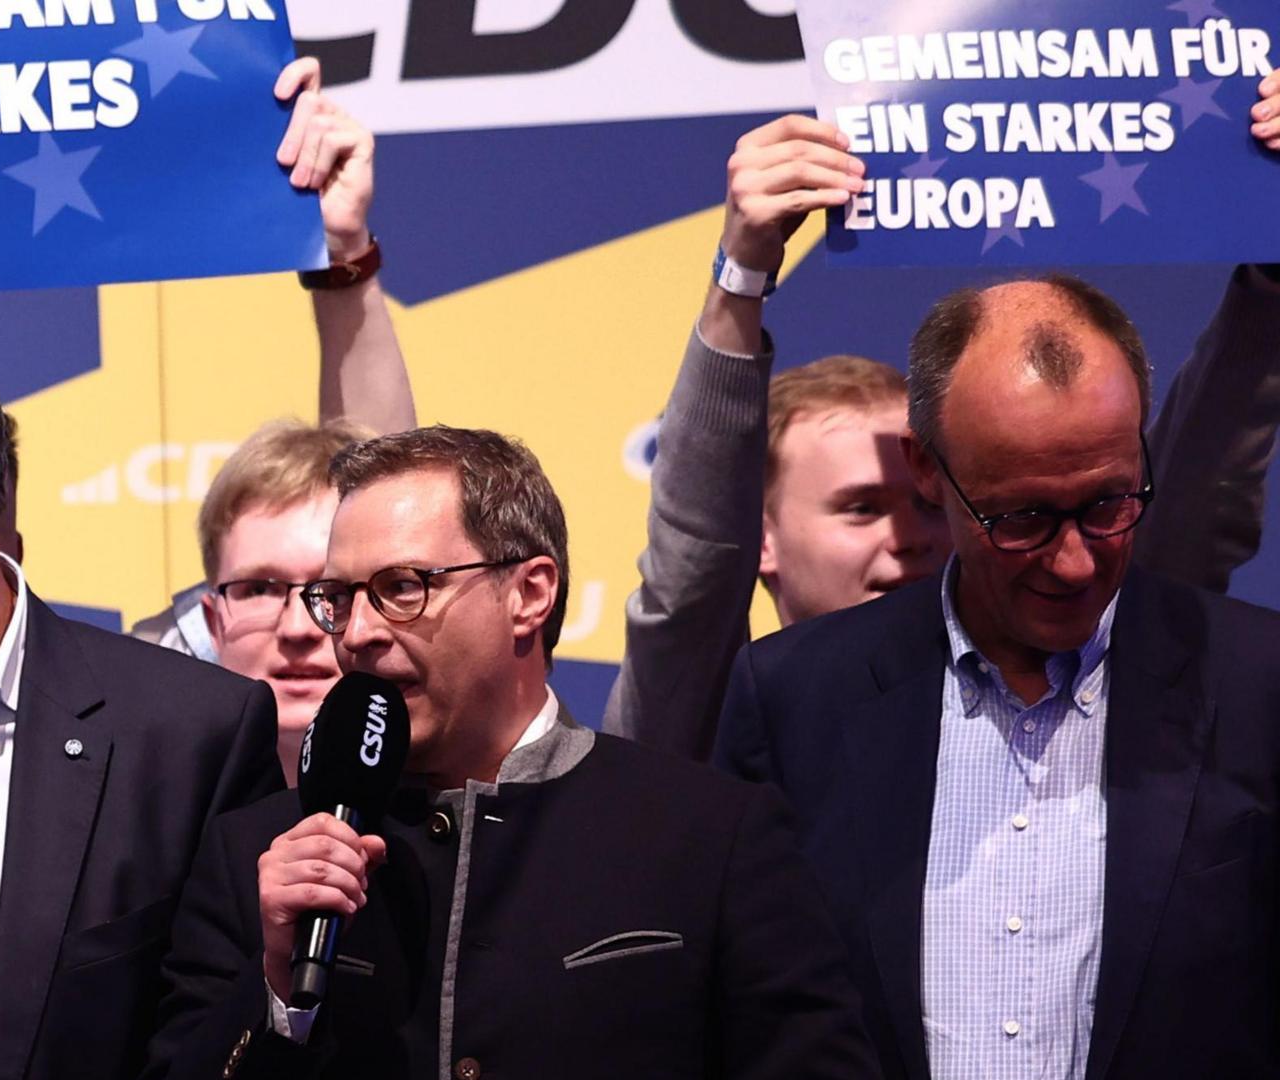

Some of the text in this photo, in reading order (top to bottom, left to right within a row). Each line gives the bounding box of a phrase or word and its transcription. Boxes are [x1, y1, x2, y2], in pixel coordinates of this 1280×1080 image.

[824, 28, 1159, 84] GEMEINSAM
[1170, 18, 1274, 78] FÜR
[835, 101, 1175, 153] EIN STARKES
[844, 177, 1056, 231] EUROPA
[359, 710, 387, 768] CSU
